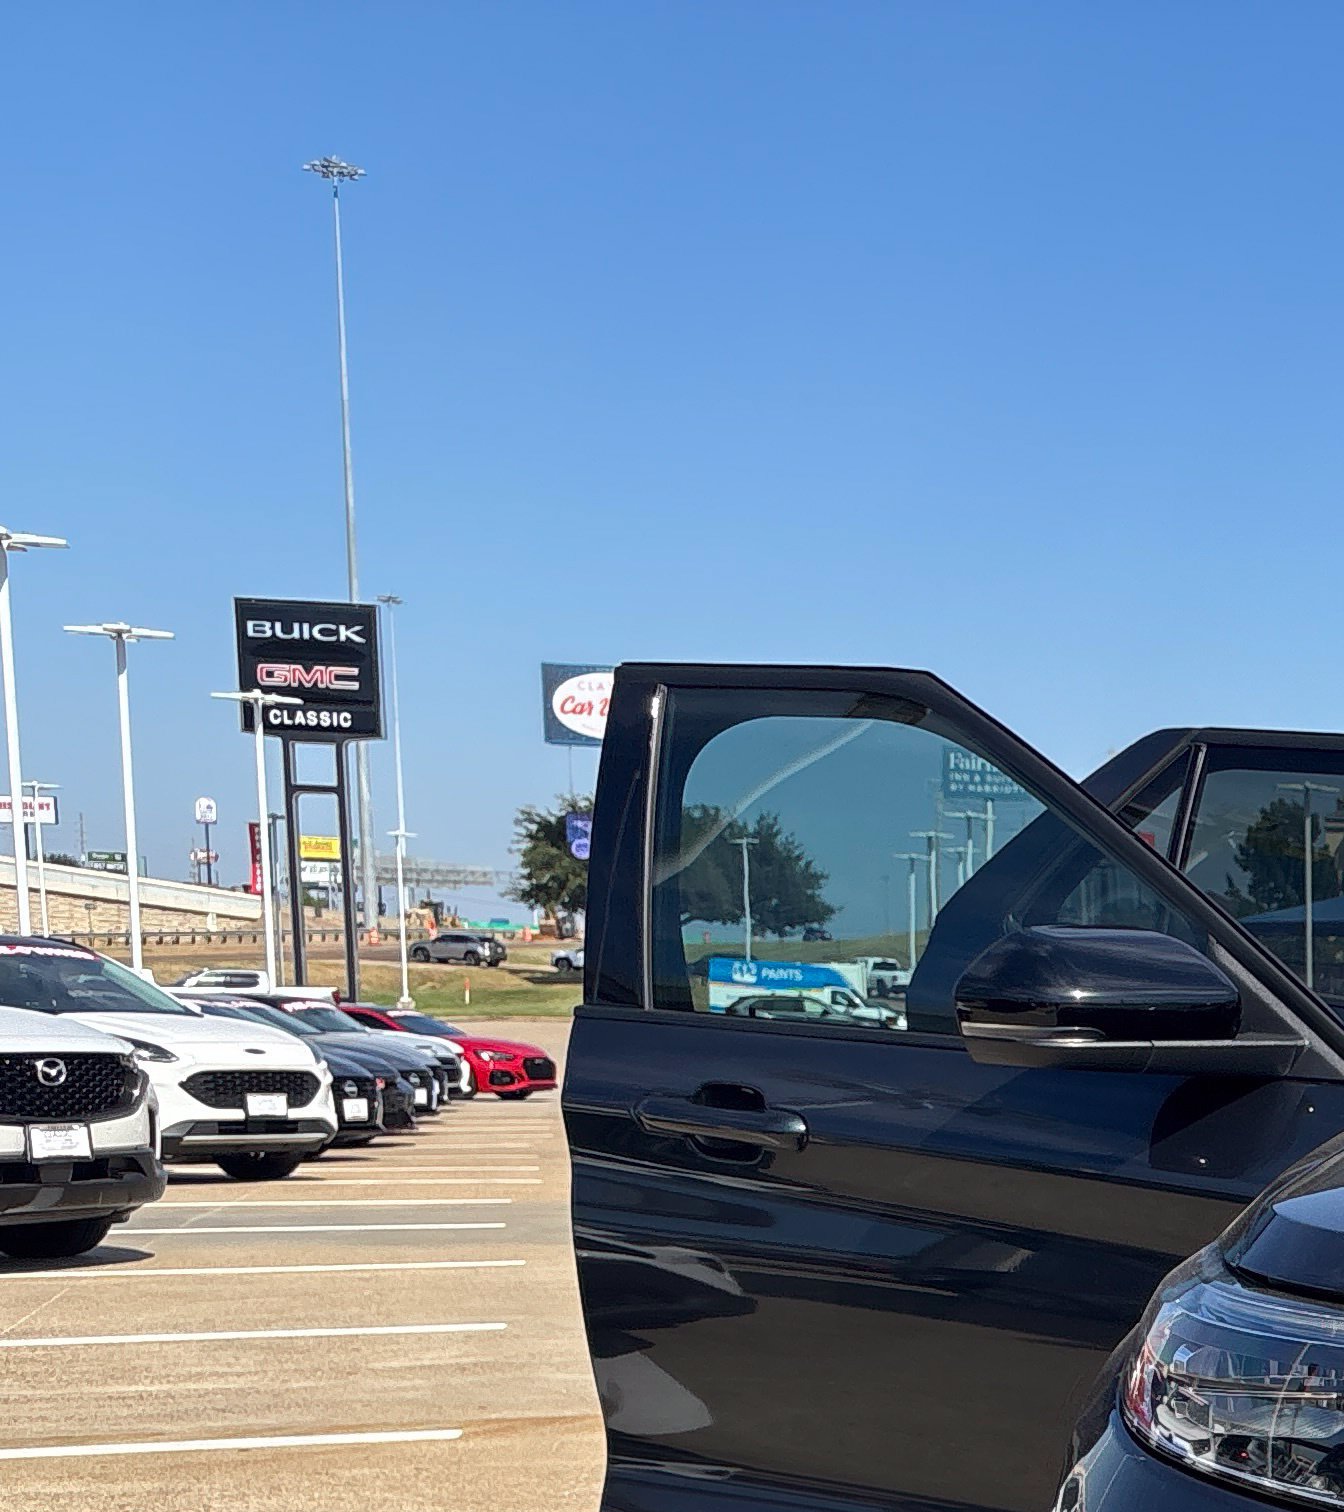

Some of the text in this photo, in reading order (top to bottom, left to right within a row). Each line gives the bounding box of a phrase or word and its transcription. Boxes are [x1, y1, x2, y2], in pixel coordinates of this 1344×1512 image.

[246, 620, 367, 644] BUICK
[256, 663, 360, 691] GMC
[577, 681, 612, 693] CLA
[560, 695, 594, 717] Car
[269, 708, 352, 728] CLASSIC
